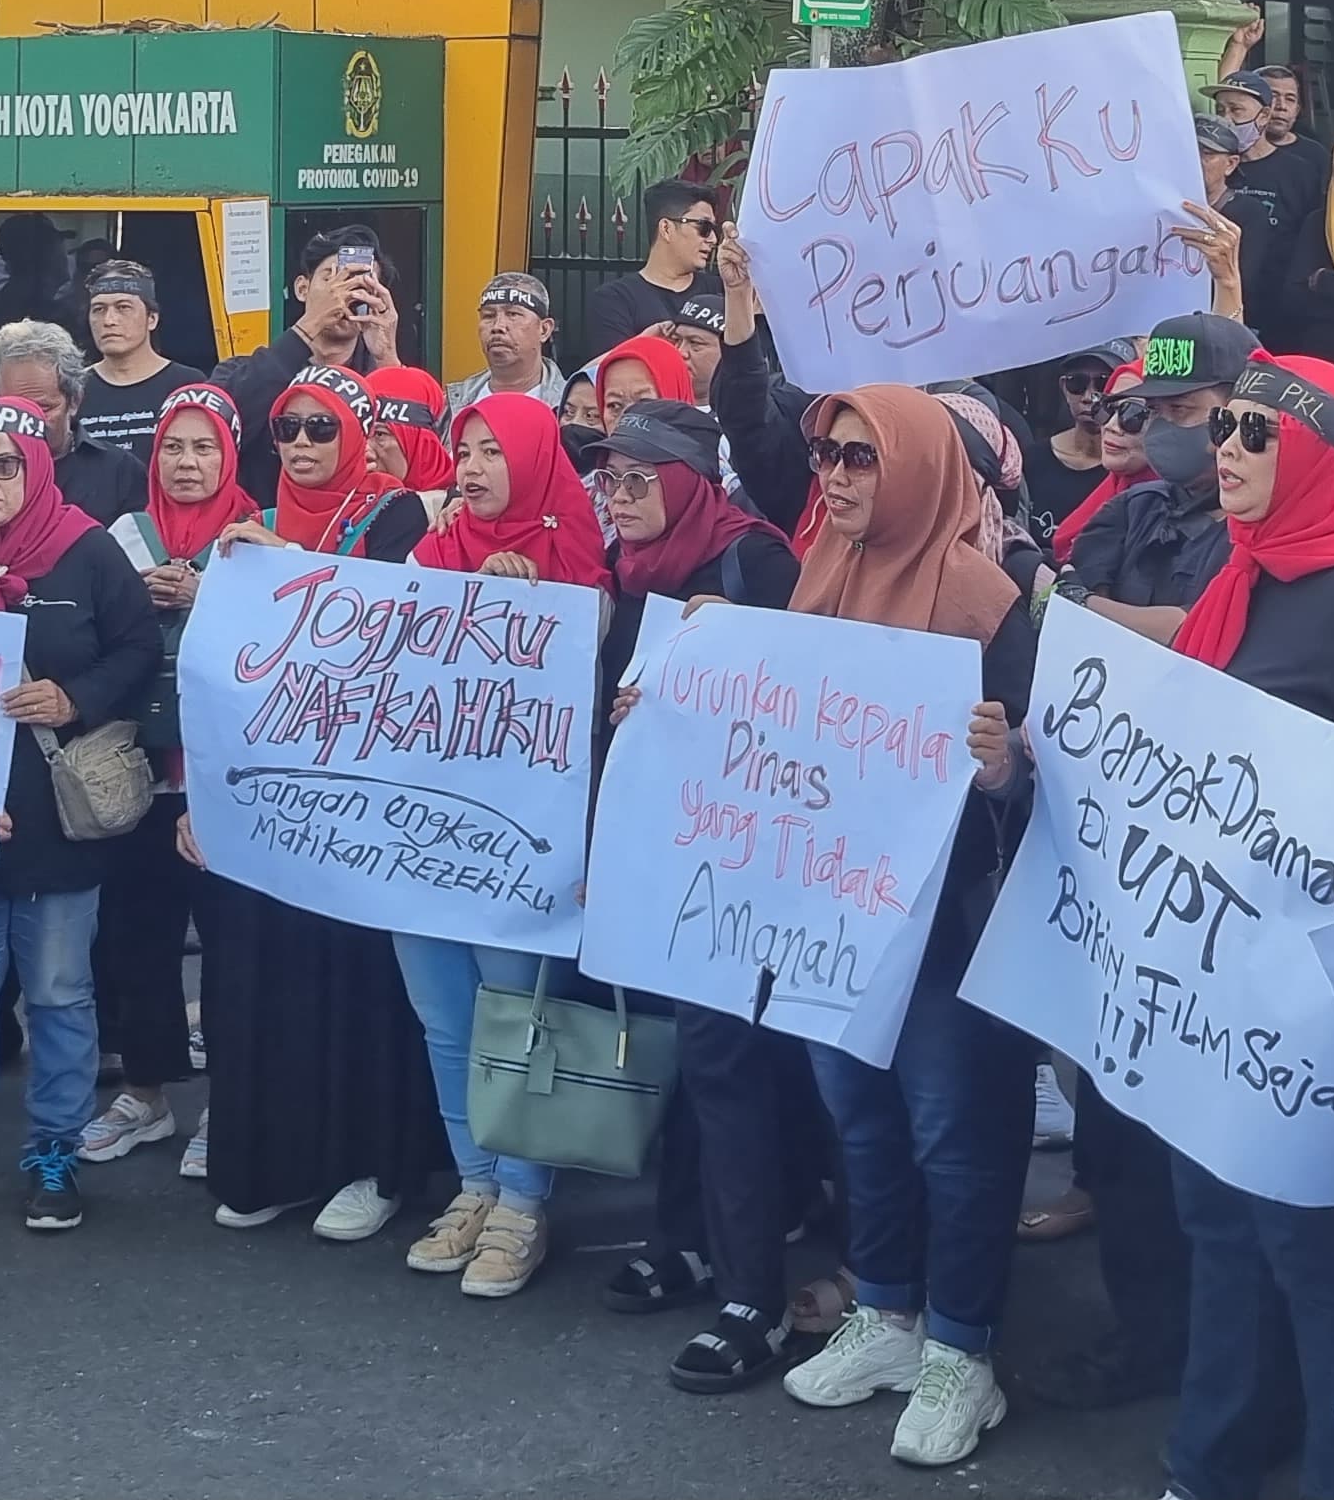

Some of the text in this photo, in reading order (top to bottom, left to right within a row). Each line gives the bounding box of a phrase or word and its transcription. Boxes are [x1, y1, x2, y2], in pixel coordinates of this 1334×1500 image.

[15, 95, 74, 137] KOTA
[80, 91, 237, 136] YOGYAKARTA
[323, 144, 396, 164] PENEGAKAN
[298, 167, 419, 189] PROTOKOL COVID-19
[509, 289, 536, 307] PKL
[1278, 382, 1327, 429] PKL
[1117, 823, 1262, 974] UPT
[667, 861, 867, 996] Amanah
